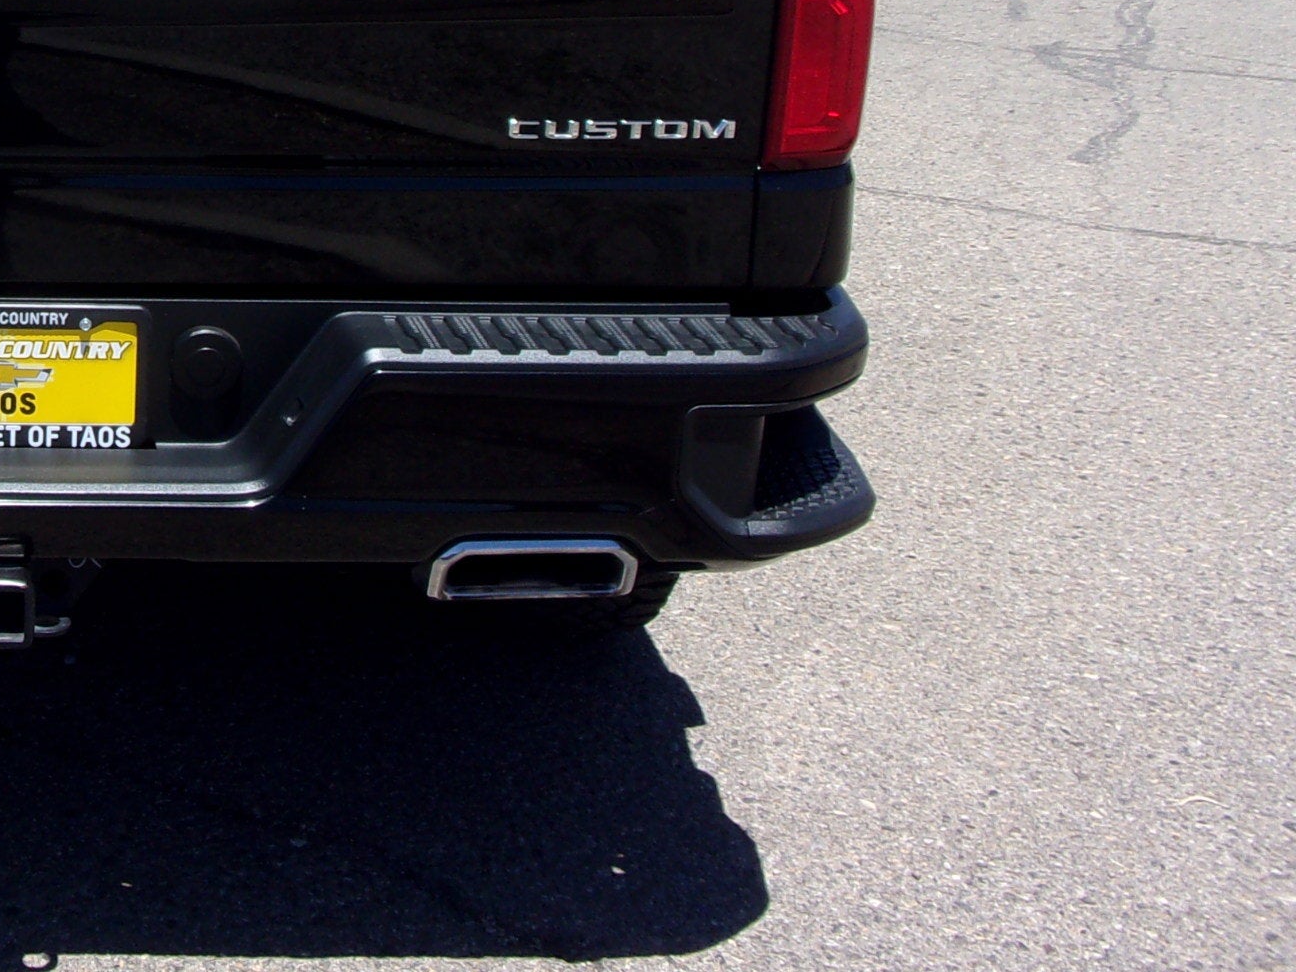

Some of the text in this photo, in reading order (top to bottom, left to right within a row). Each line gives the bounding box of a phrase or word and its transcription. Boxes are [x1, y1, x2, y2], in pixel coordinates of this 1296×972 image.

[507, 118, 737, 140] CUSTOM
[28, 425, 61, 448] OF
[66, 426, 131, 449] TAOS
